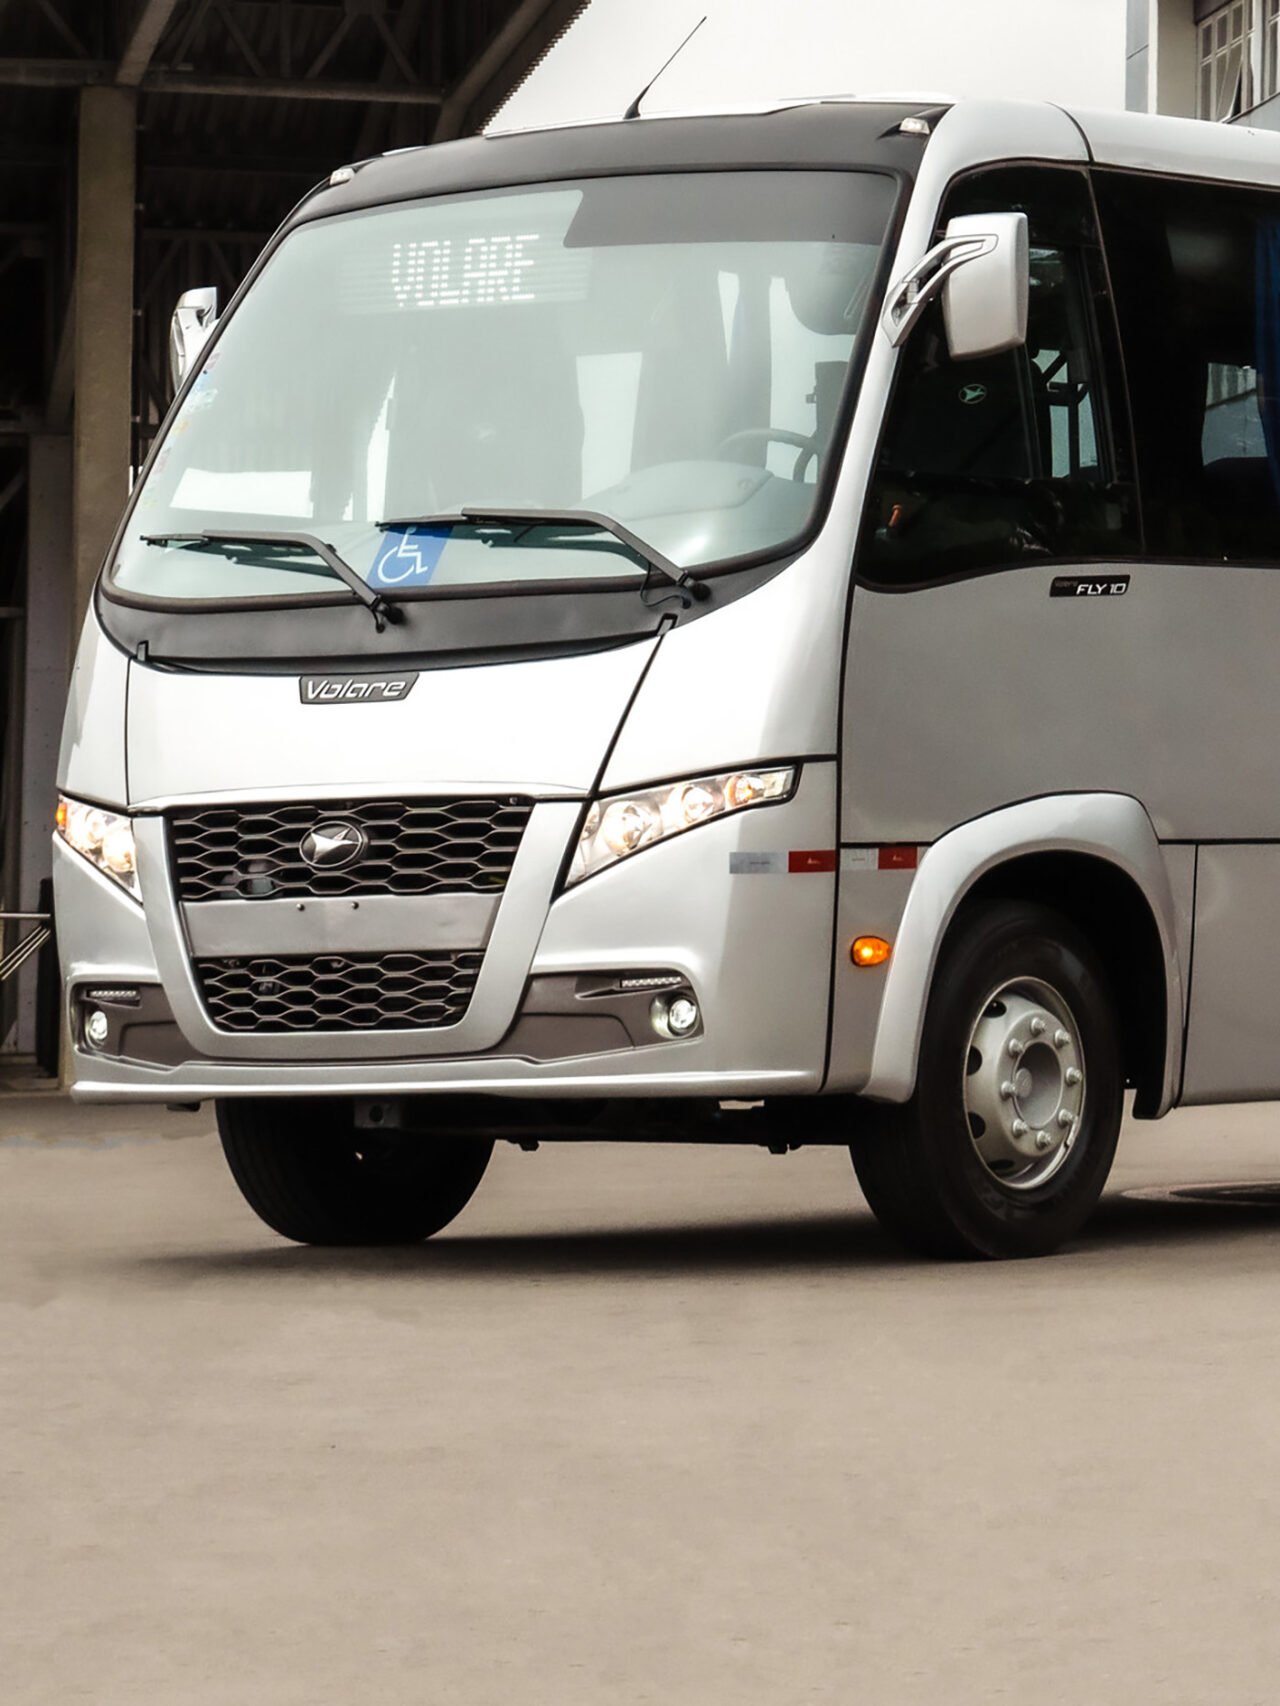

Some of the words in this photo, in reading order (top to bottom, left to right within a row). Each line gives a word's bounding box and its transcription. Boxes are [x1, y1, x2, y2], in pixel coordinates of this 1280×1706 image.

[391, 235, 540, 307] VOLARE
[1076, 583, 1107, 595] FLY
[1110, 582, 1127, 594] 10
[308, 679, 406, 699] Volare
